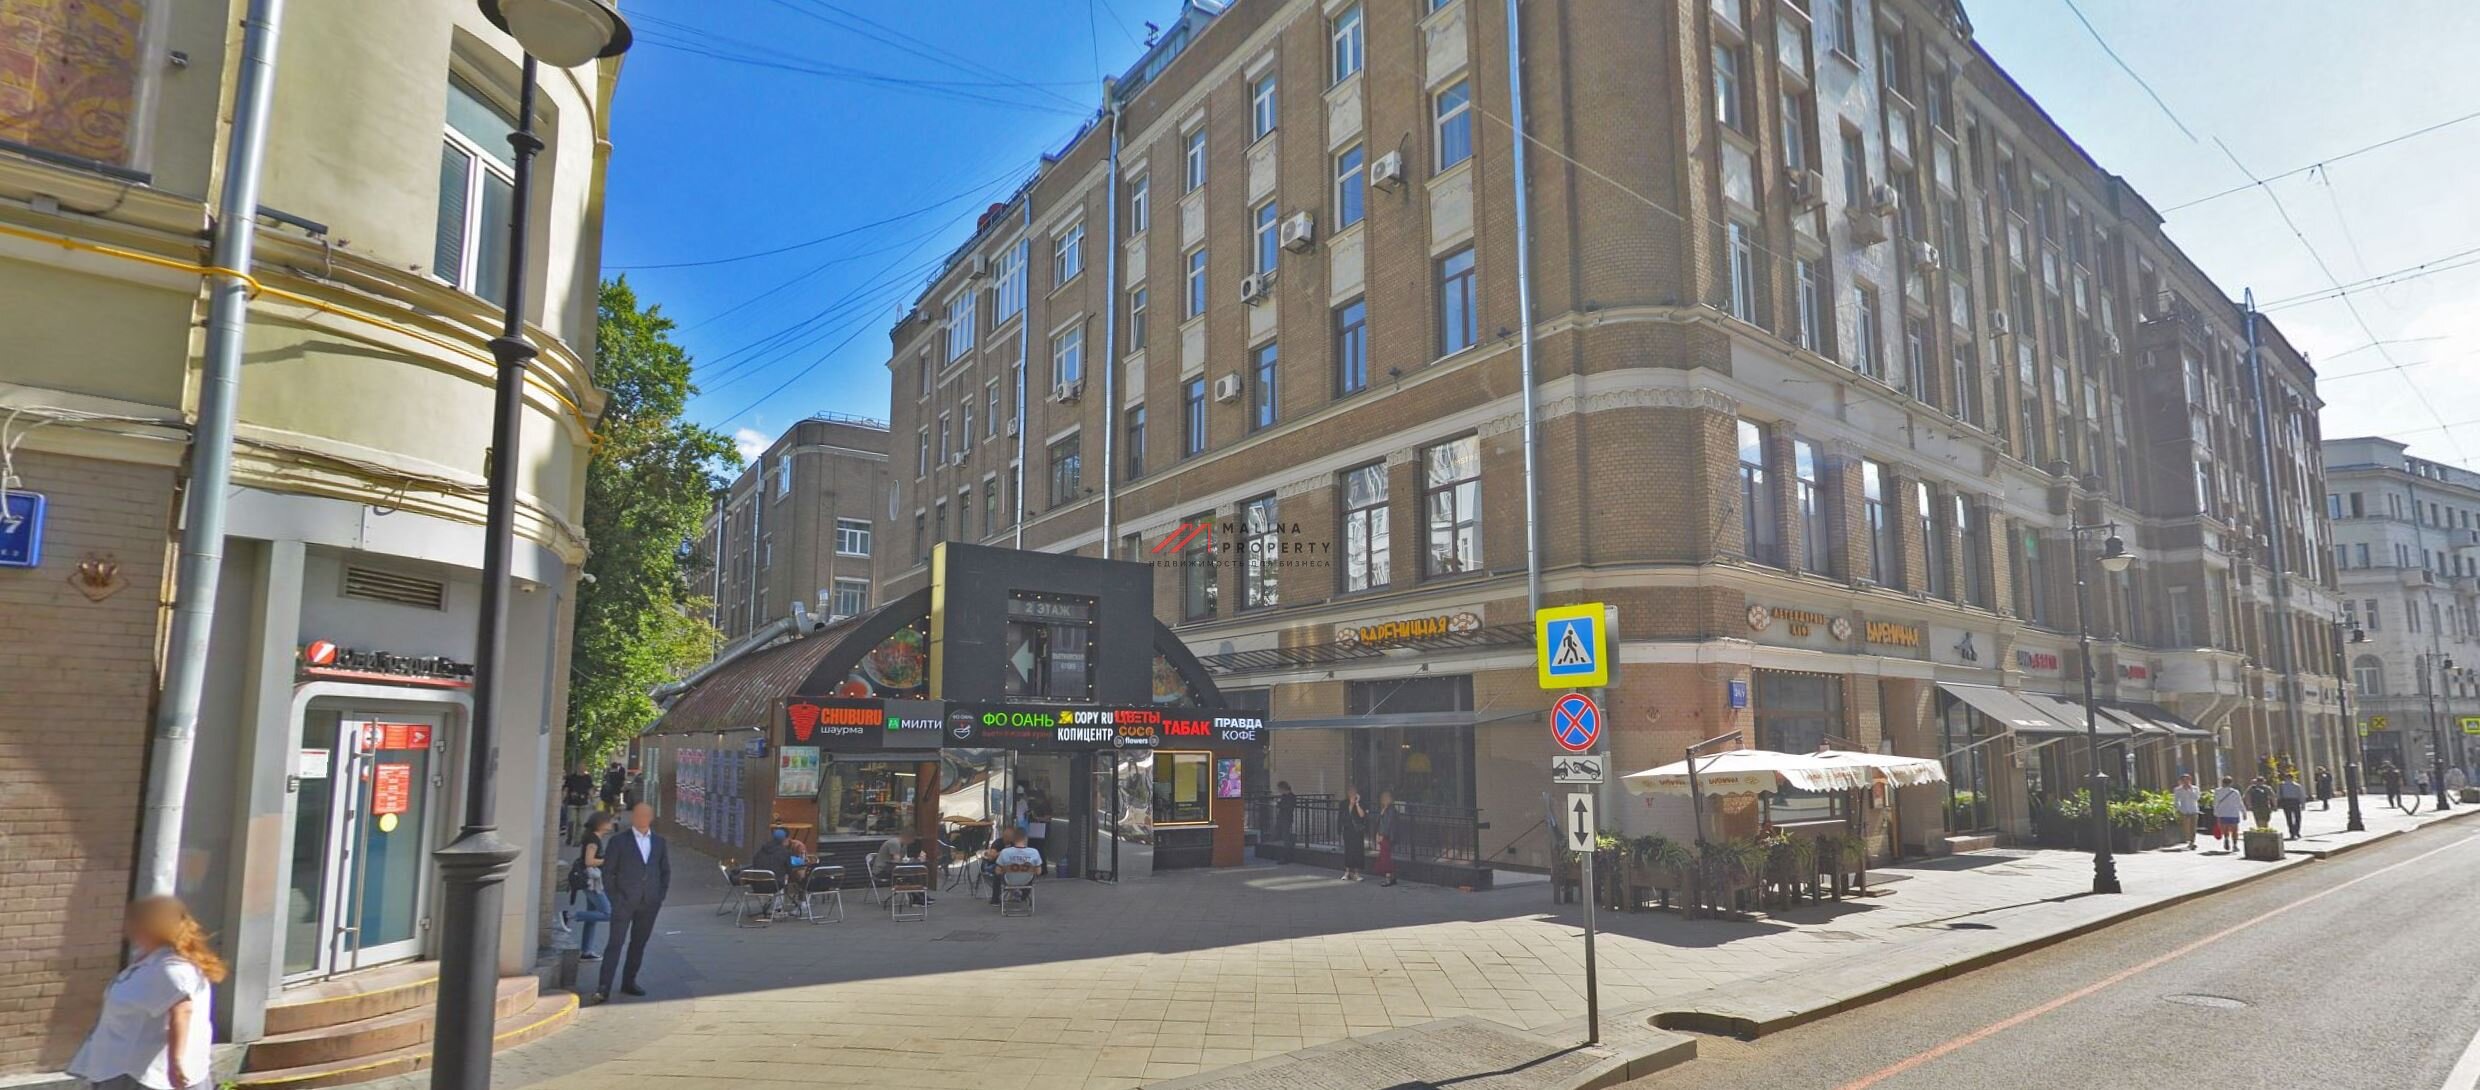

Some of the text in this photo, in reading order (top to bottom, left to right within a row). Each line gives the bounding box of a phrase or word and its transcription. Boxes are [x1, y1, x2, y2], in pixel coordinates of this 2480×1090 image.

[1025, 602, 1071, 616] 2 ЭТАЖ
[821, 707, 883, 725] CHUBURU
[982, 712, 1055, 727] ФО ОАНЬ
[1075, 711, 1114, 725] COPY RU
[1114, 710, 1161, 726] ЦВЕТЫ
[821, 726, 864, 735] шаурма
[901, 719, 942, 729] МИЛТИ
[1162, 720, 1211, 735] ТАБАК
[1214, 718, 1263, 729] ПРАВДА
[1057, 728, 1114, 742] КОПИЦЕНТР
[1125, 737, 1148, 745] flowers
[1222, 730, 1256, 740] КОФЕ
